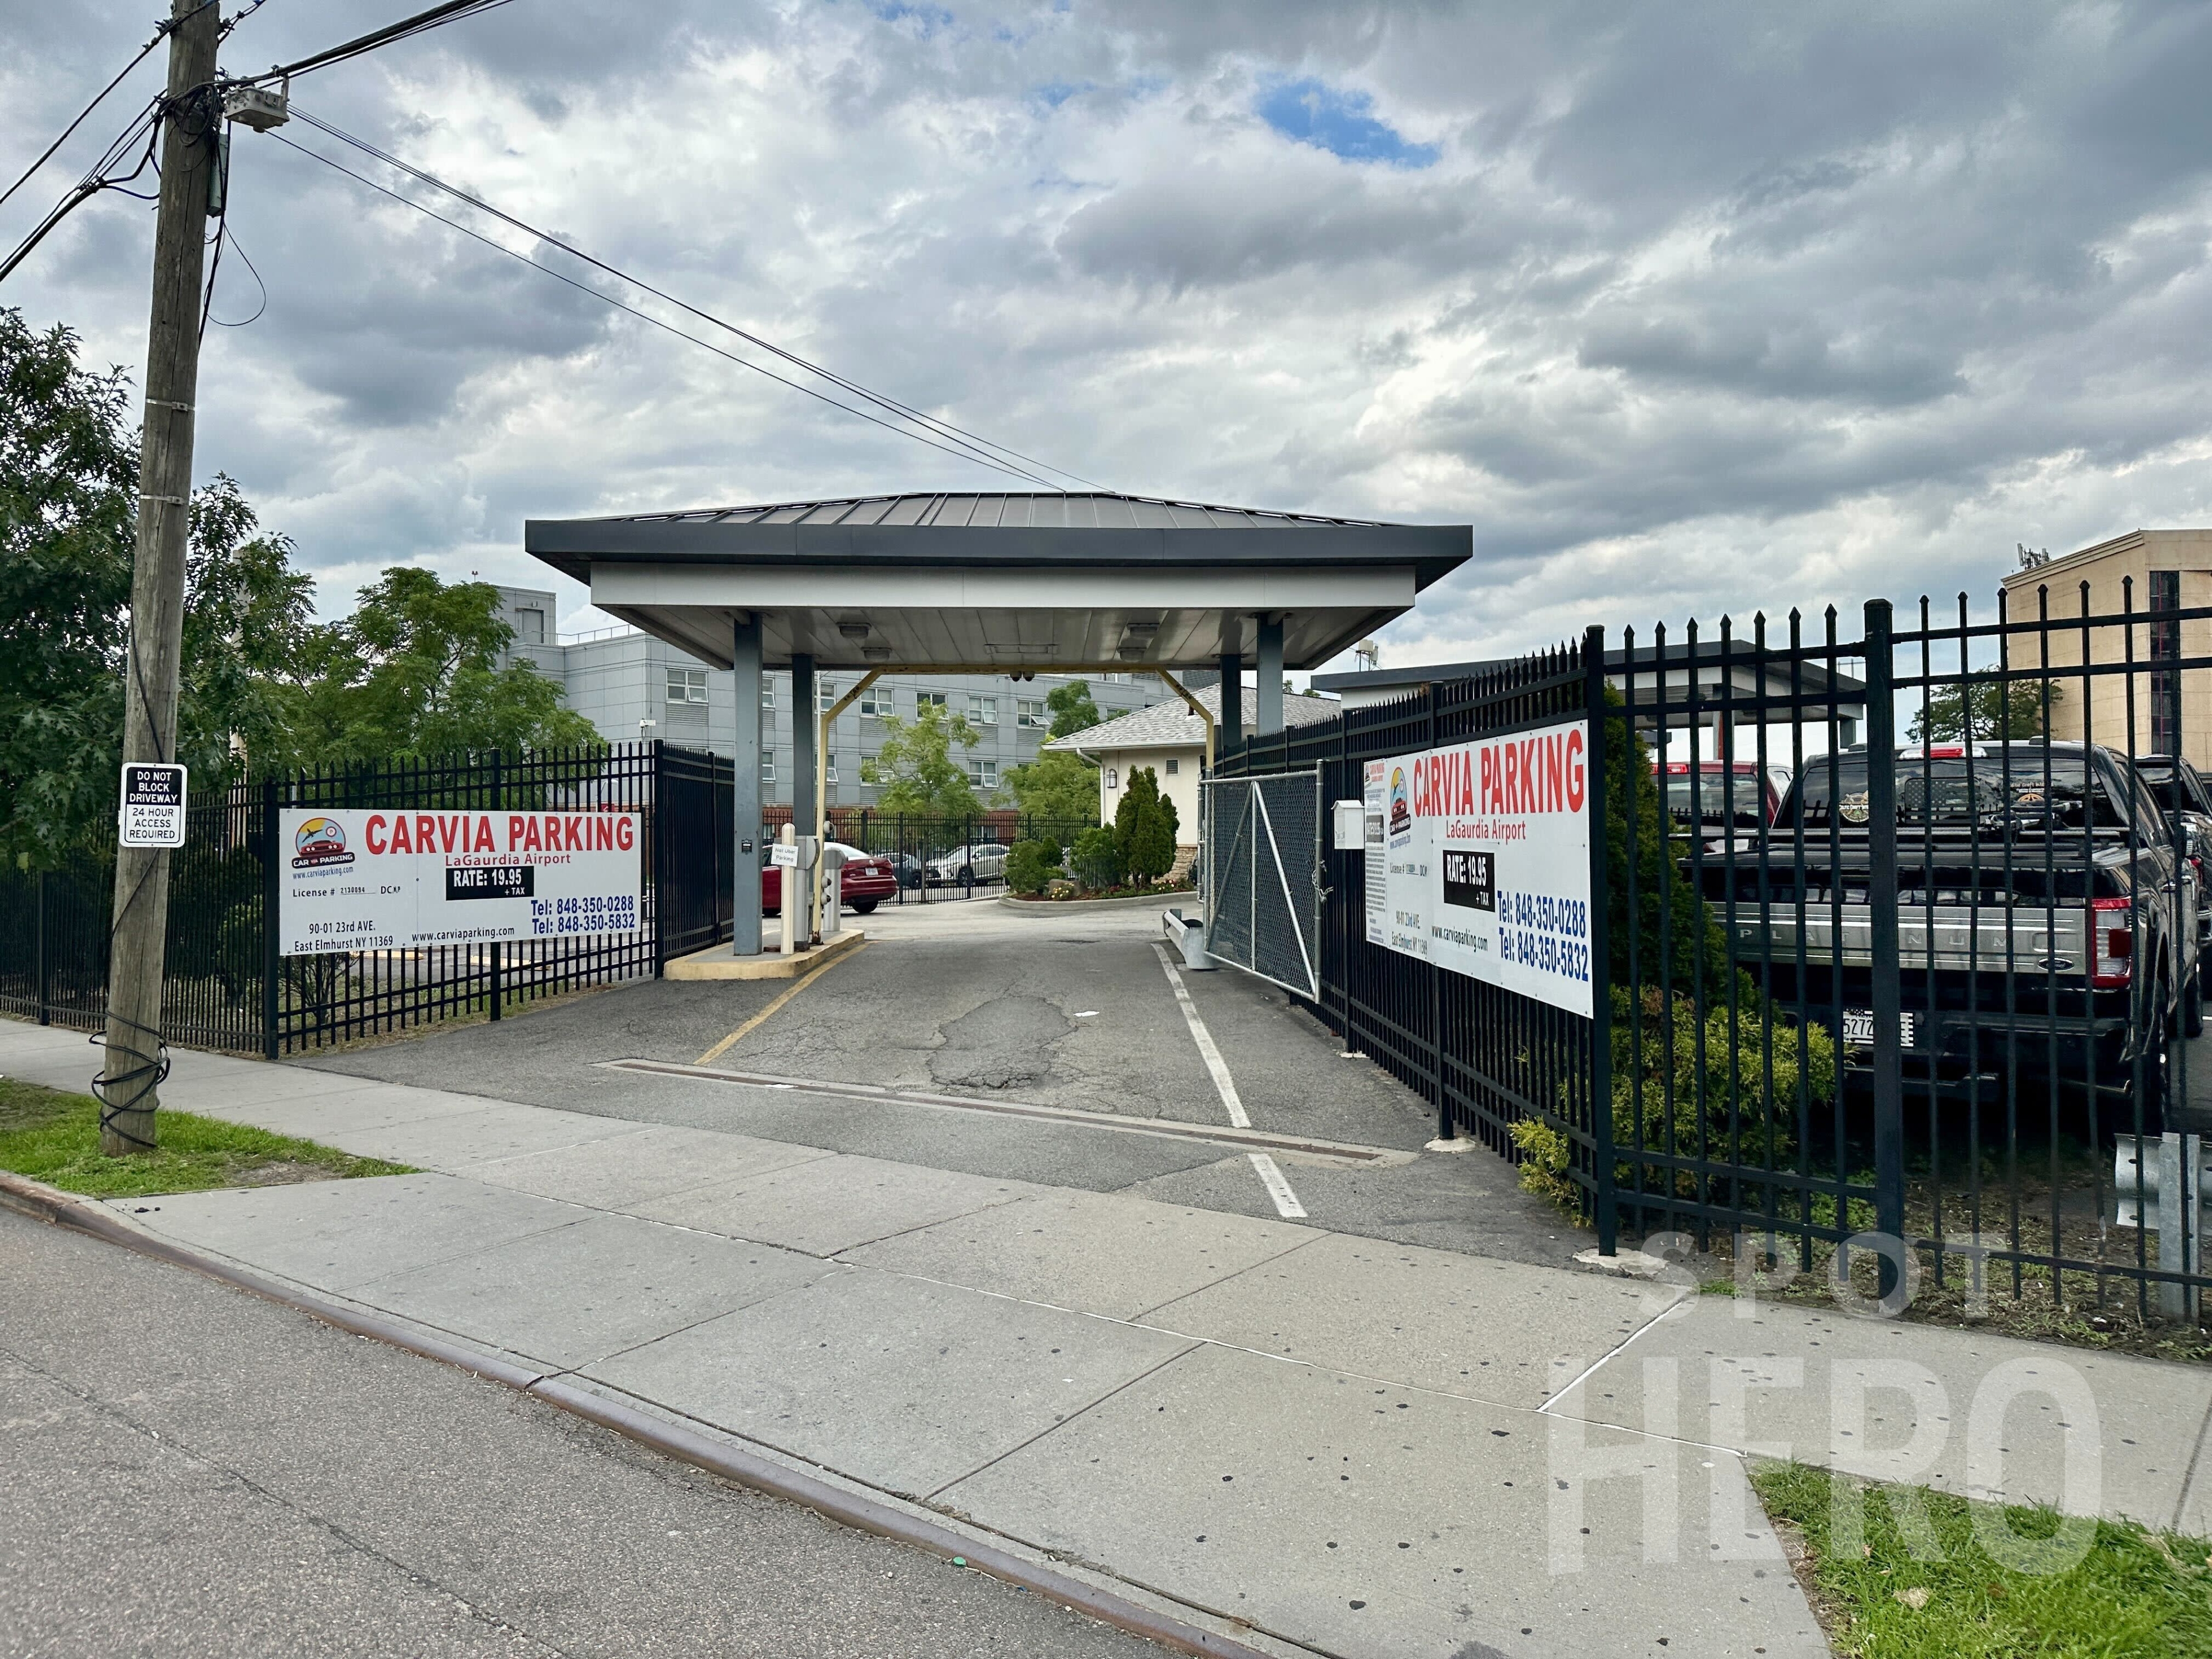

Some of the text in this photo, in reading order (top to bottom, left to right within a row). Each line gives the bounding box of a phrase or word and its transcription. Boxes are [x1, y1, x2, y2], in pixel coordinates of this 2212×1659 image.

[137, 771, 172, 781] DO NOT
[1414, 729, 1585, 818] CARVIA PARKING
[139, 782, 169, 792] BLOCK
[129, 793, 178, 804] DRIVEWAY
[132, 808, 173, 817] 24 HOUR
[134, 819, 171, 828] ACCESS
[130, 830, 175, 839] REQUIRED
[366, 815, 634, 854] CARVIA PARKING
[1446, 819, 1527, 845] LaGaurdia Airport
[293, 859, 309, 867] CAR
[320, 854, 353, 863] PARKING
[445, 853, 571, 867] LaGaurdia Airport
[293, 866, 354, 880] www.carviaparking.com
[1390, 862, 1402, 874] License
[1446, 854, 1487, 887] RATE: 19.95
[453, 868, 521, 887] RATE: 19.95
[293, 888, 327, 897] License
[330, 888, 335, 896] #
[511, 887, 525, 895] TAX
[531, 895, 634, 916] Tel: 848-350-0288
[1480, 892, 1489, 906] TAX
[1498, 891, 1586, 938] Tel: 848-350-0288
[309, 920, 376, 934] 90-01 23rd AVE.
[532, 913, 635, 934] Tel: 848-350-5832
[412, 926, 514, 942] www.carviaparking.com
[1431, 925, 1488, 952] www.carviaparking.com
[1740, 929, 2008, 947] PLATNUM
[295, 935, 393, 952] East Elmhurst NY 11369
[1499, 927, 1588, 982] Tel: 848-350-5832
